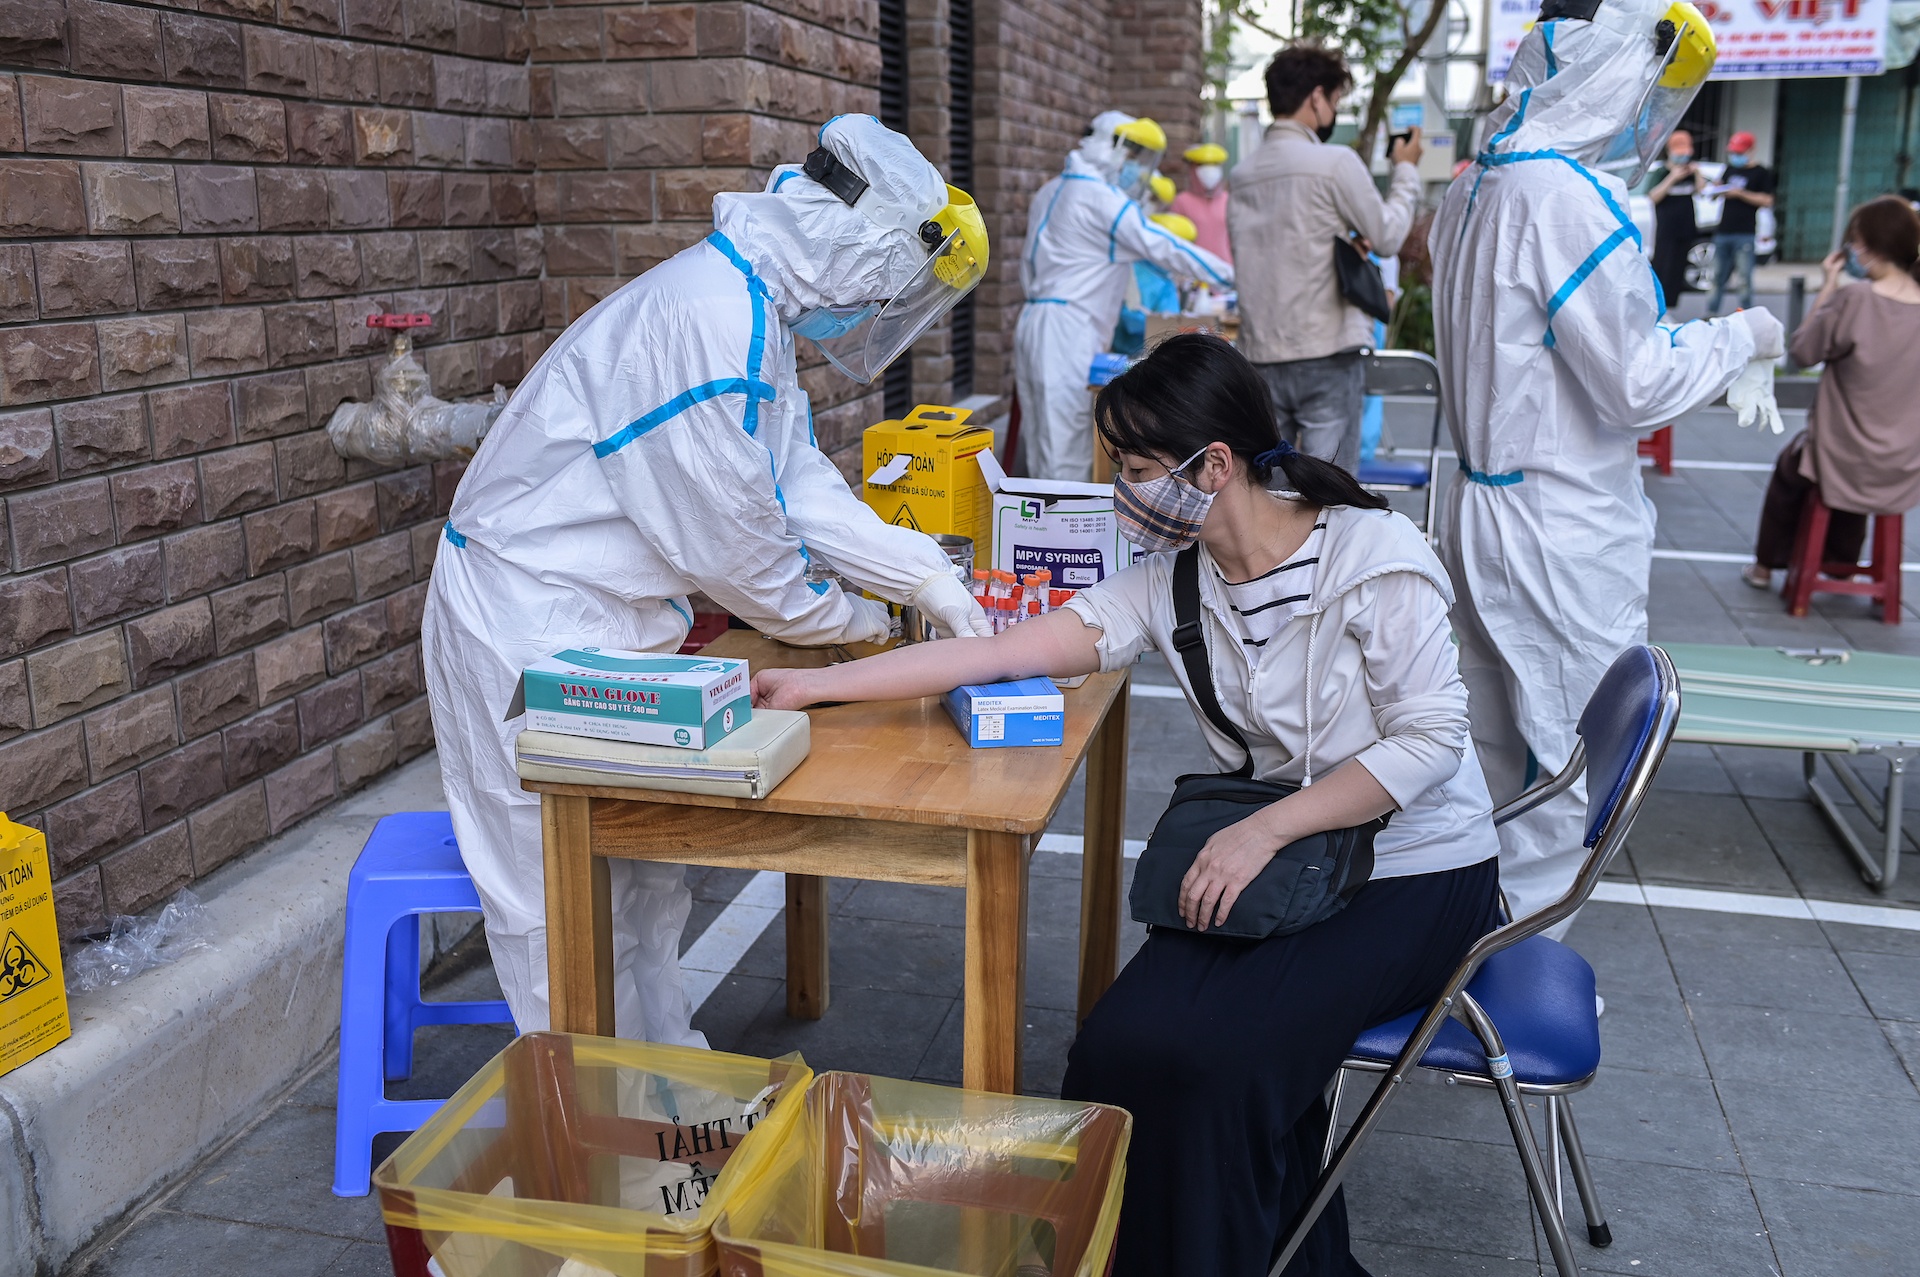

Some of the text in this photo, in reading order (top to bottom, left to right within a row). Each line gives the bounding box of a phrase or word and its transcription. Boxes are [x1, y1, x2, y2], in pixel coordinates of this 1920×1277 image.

[911, 452, 934, 473] TOÀN
[929, 488, 945, 499] DỤNG
[1016, 549, 1101, 564] MPV SYRINGE
[1069, 572, 1075, 580] 5
[709, 686, 723, 698] VINA
[724, 672, 742, 689] GLOVE
[559, 683, 661, 705] VINA GLOVE
[582, 699, 593, 708] TAY
[594, 702, 607, 710] CAO
[608, 703, 616, 711] SU
[617, 704, 622, 712] Y
[623, 703, 631, 712] TẾ
[633, 706, 645, 714] 240
[726, 711, 730, 723] S
[8, 859, 34, 888] TOÀN
